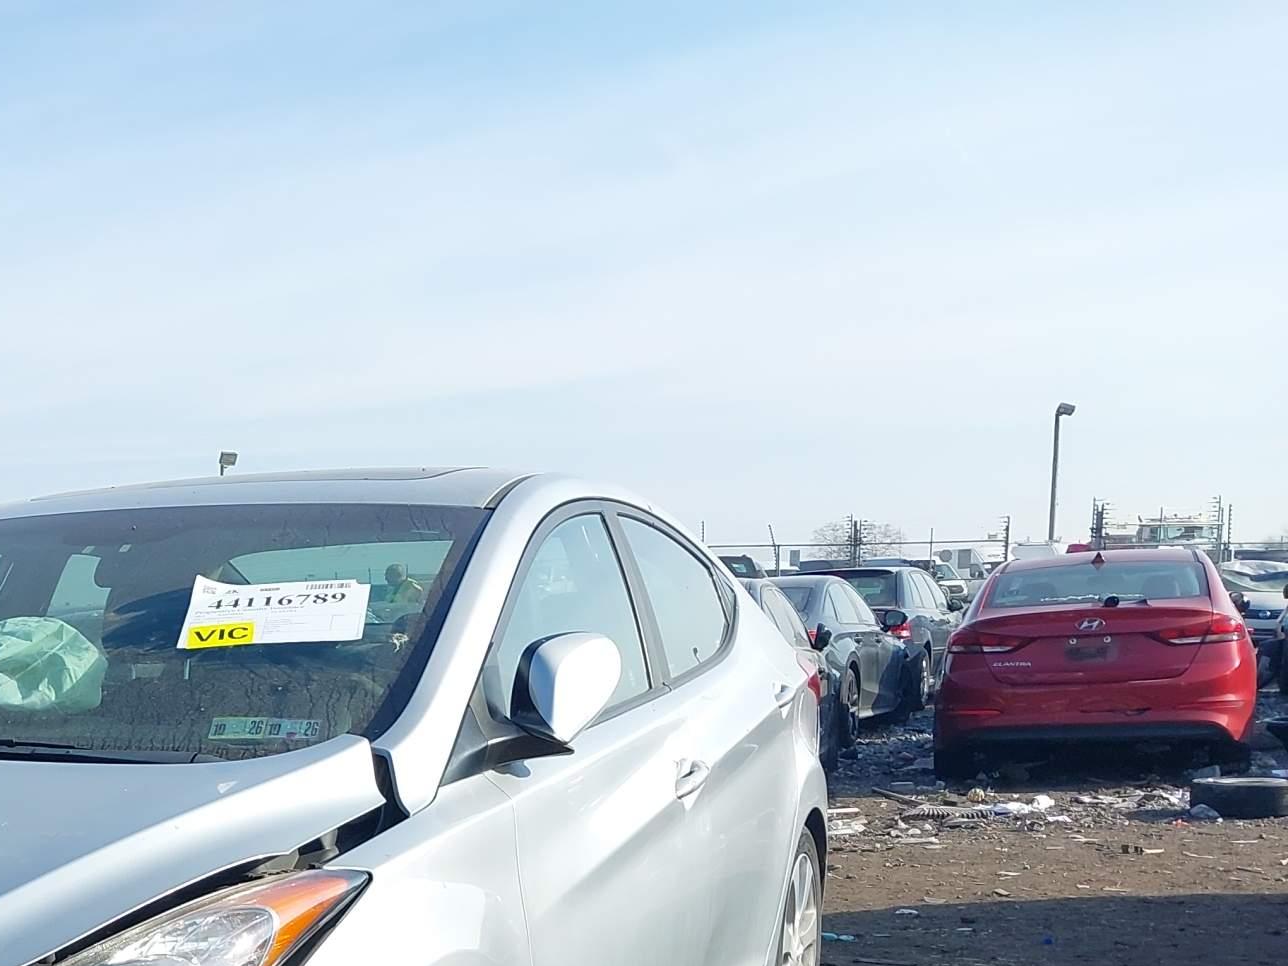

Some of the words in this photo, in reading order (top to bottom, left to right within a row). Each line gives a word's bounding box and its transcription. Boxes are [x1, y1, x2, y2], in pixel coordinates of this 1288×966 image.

[208, 592, 347, 610] 44116789
[194, 627, 249, 643] VIC
[248, 720, 264, 735] 26
[303, 721, 320, 737] 26
